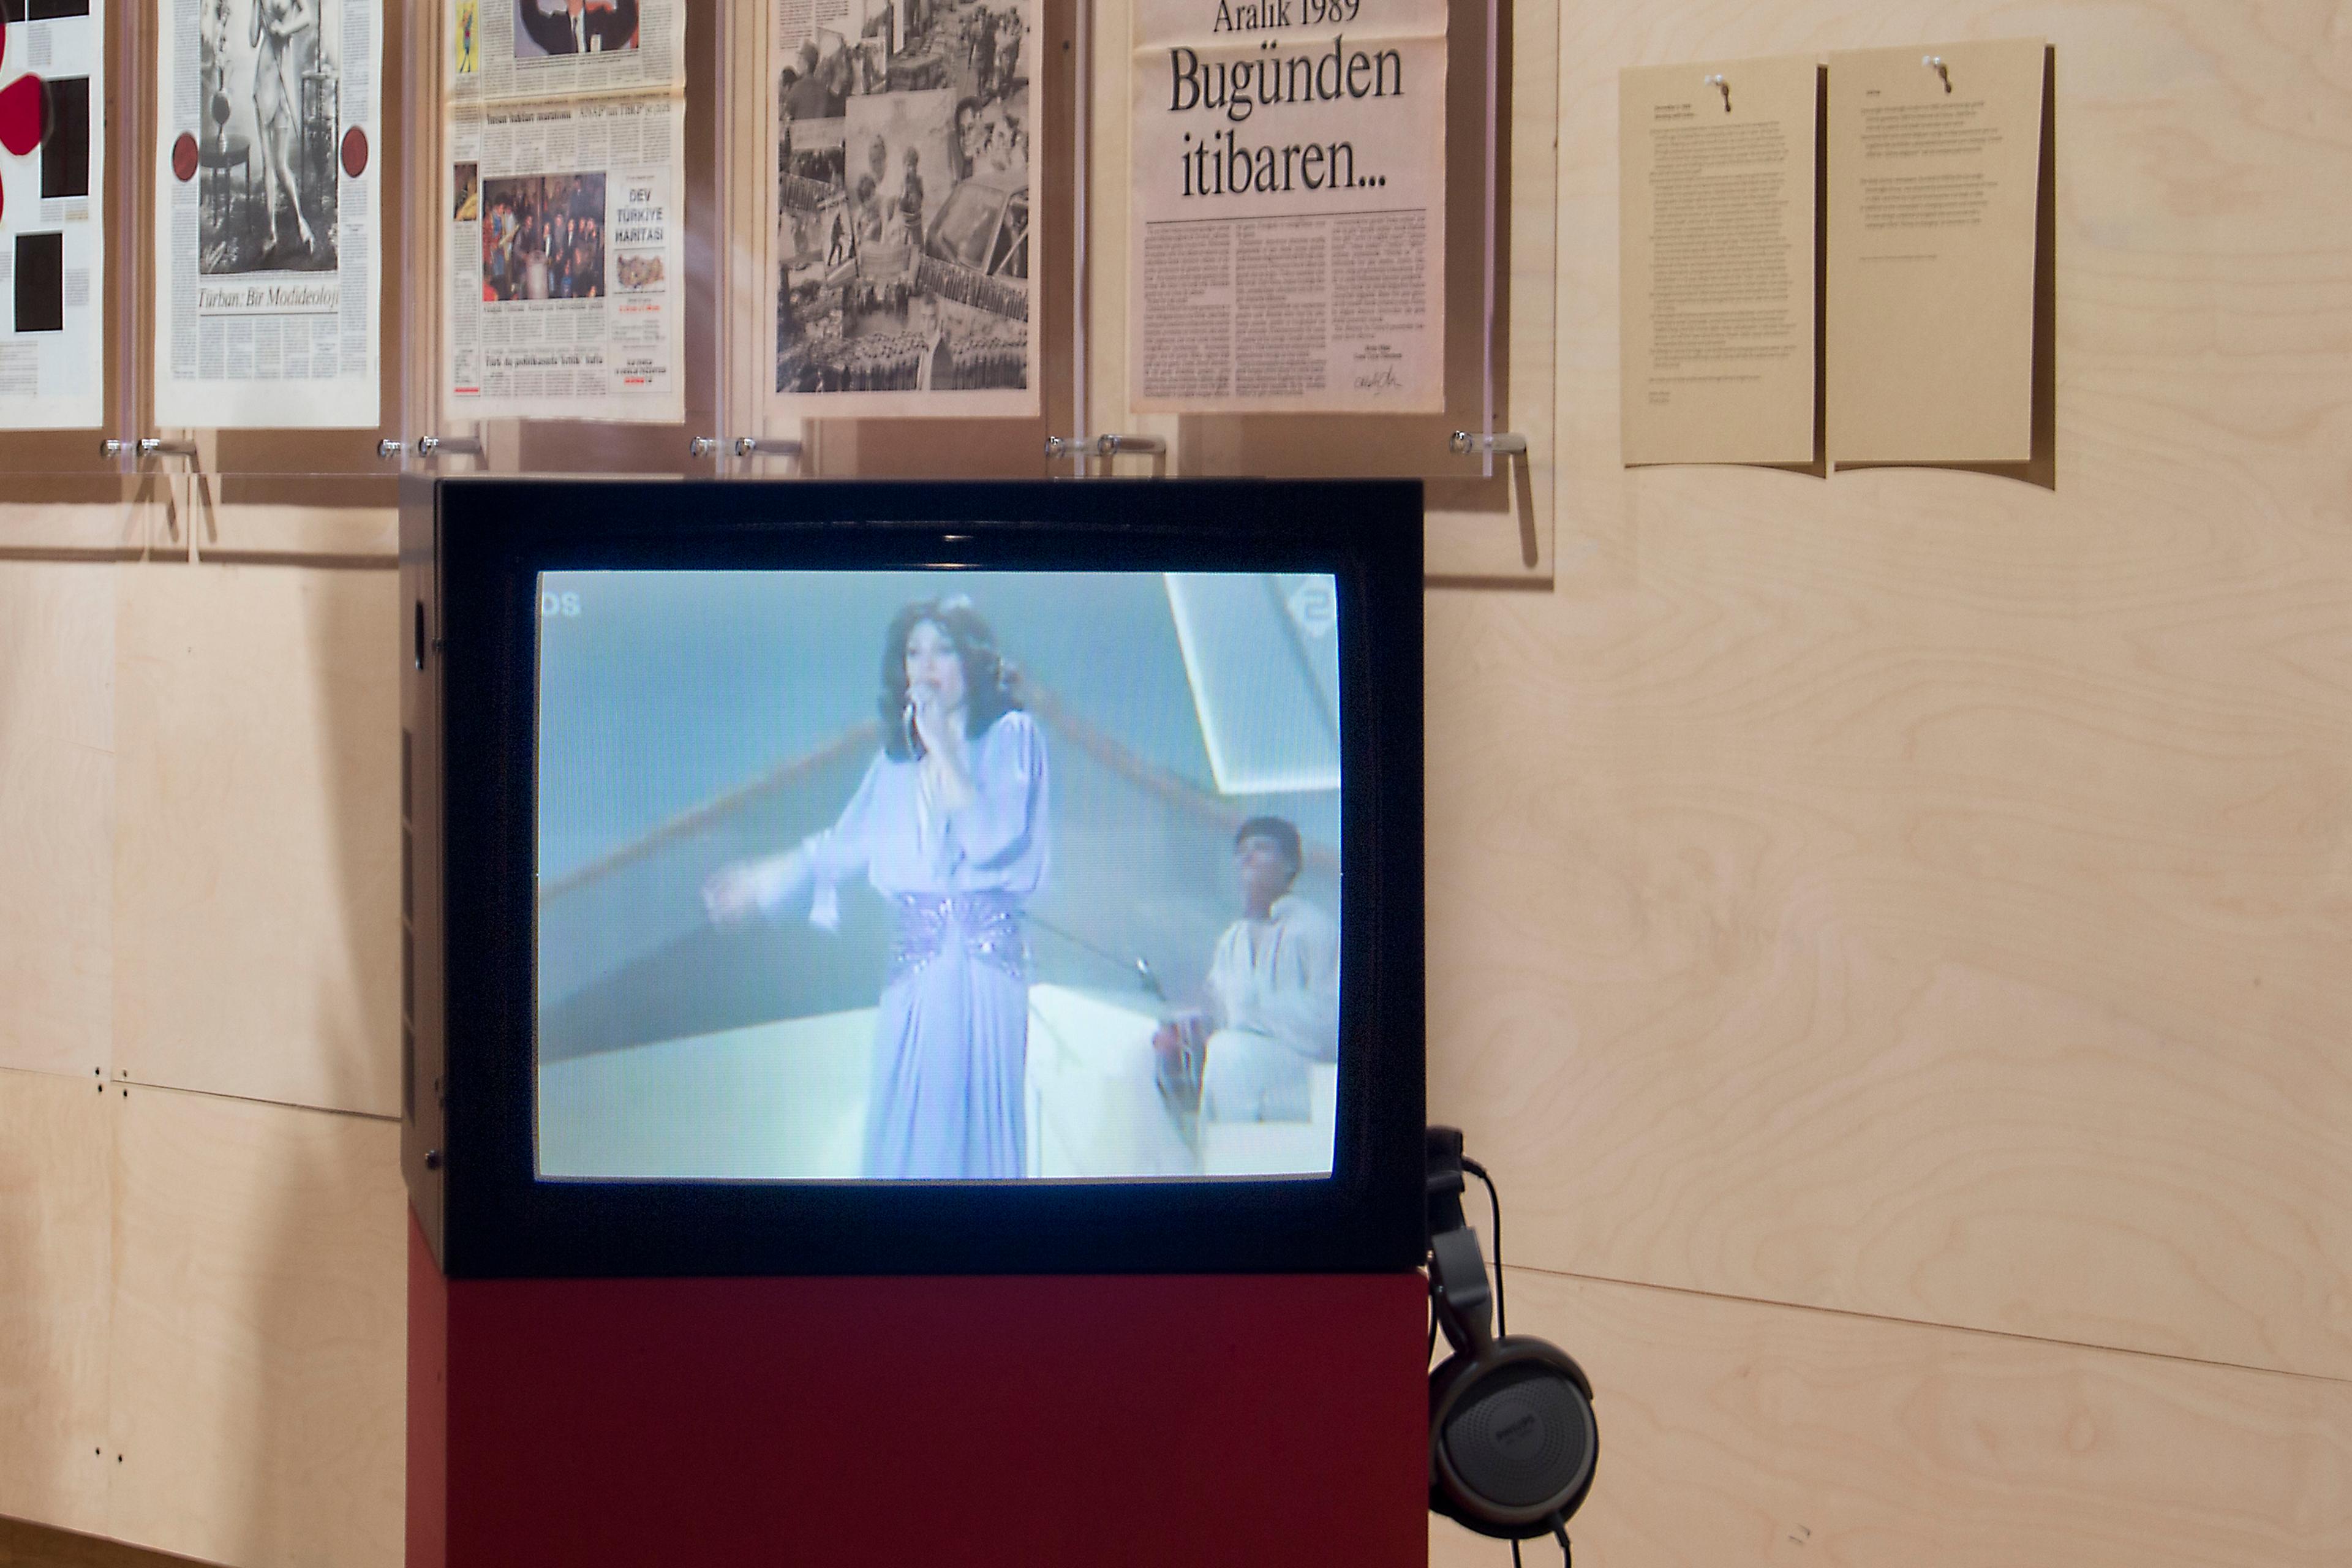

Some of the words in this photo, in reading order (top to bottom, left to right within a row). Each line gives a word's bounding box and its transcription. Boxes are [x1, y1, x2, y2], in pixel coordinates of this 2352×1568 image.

[1213, 0, 1292, 32] Aralık
[1300, 0, 1360, 25] 1989
[1167, 33, 1404, 121] Bugünden
[1182, 128, 1387, 197] itibaren...
